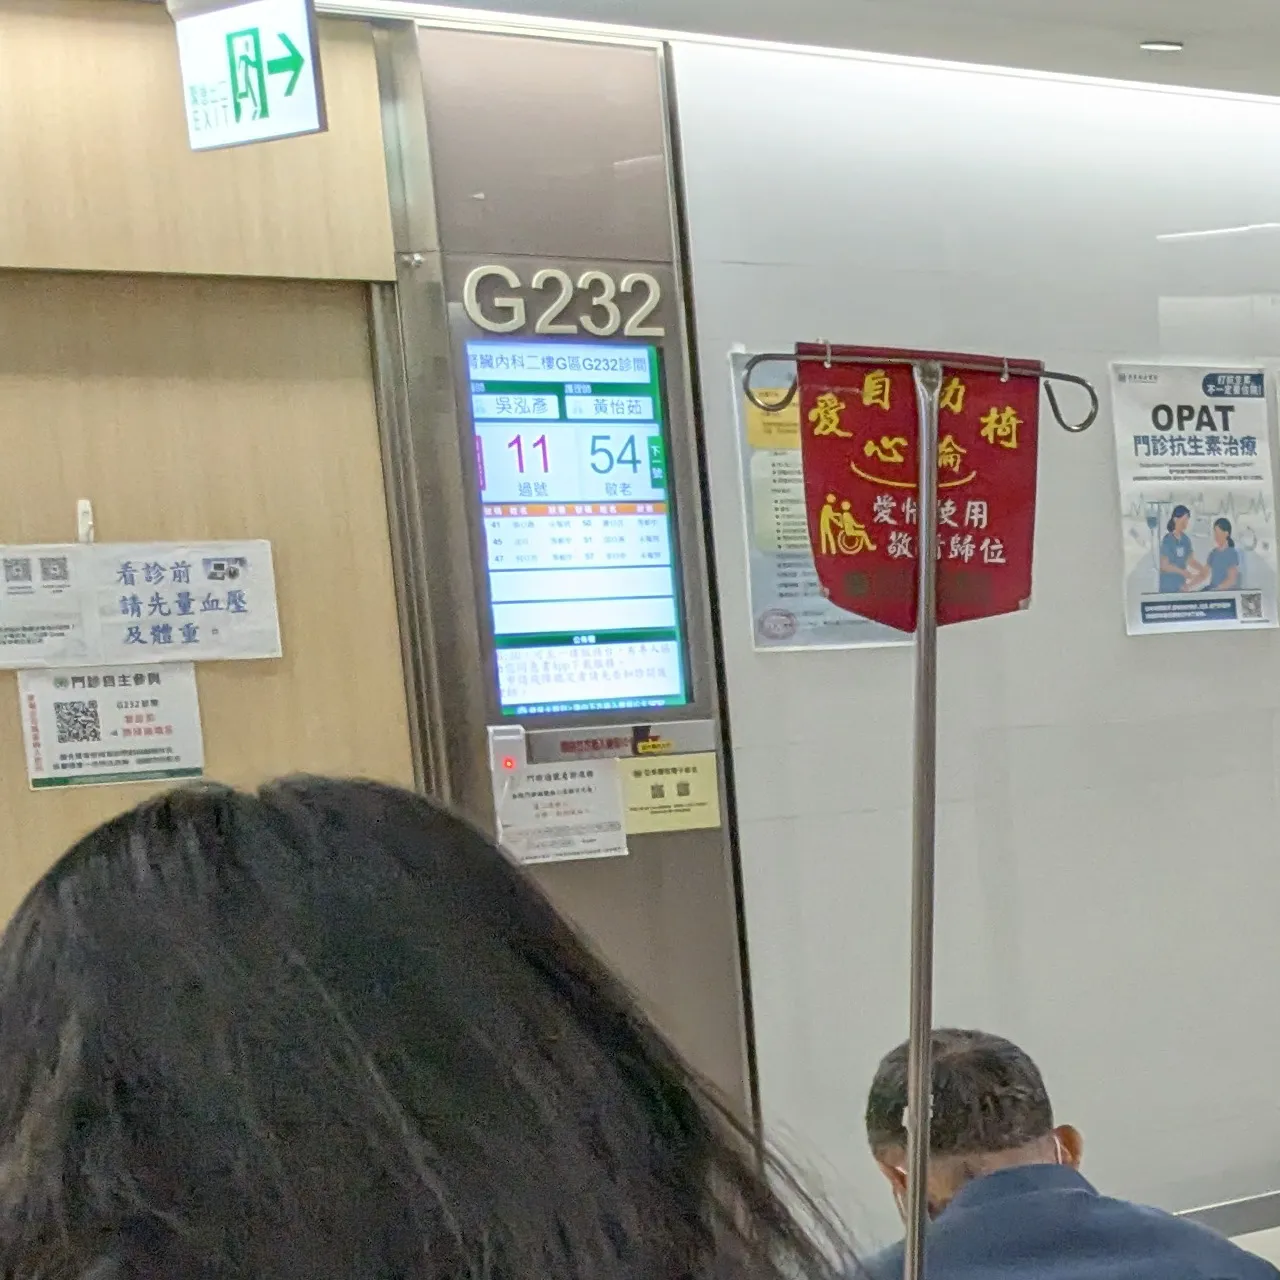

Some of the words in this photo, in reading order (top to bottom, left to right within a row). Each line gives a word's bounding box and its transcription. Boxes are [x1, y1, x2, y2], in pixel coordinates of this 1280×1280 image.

[192, 104, 229, 131] EXIT
[463, 264, 665, 337] G232
[1152, 404, 1235, 432] OPAT
[508, 434, 549, 473] 11
[590, 434, 641, 474] 54
[1133, 435, 1258, 457] 門診抗生素治療
[888, 531, 1006, 564] 敬歸位
[116, 561, 192, 586] 看診前
[119, 590, 248, 617] 請先量血壓
